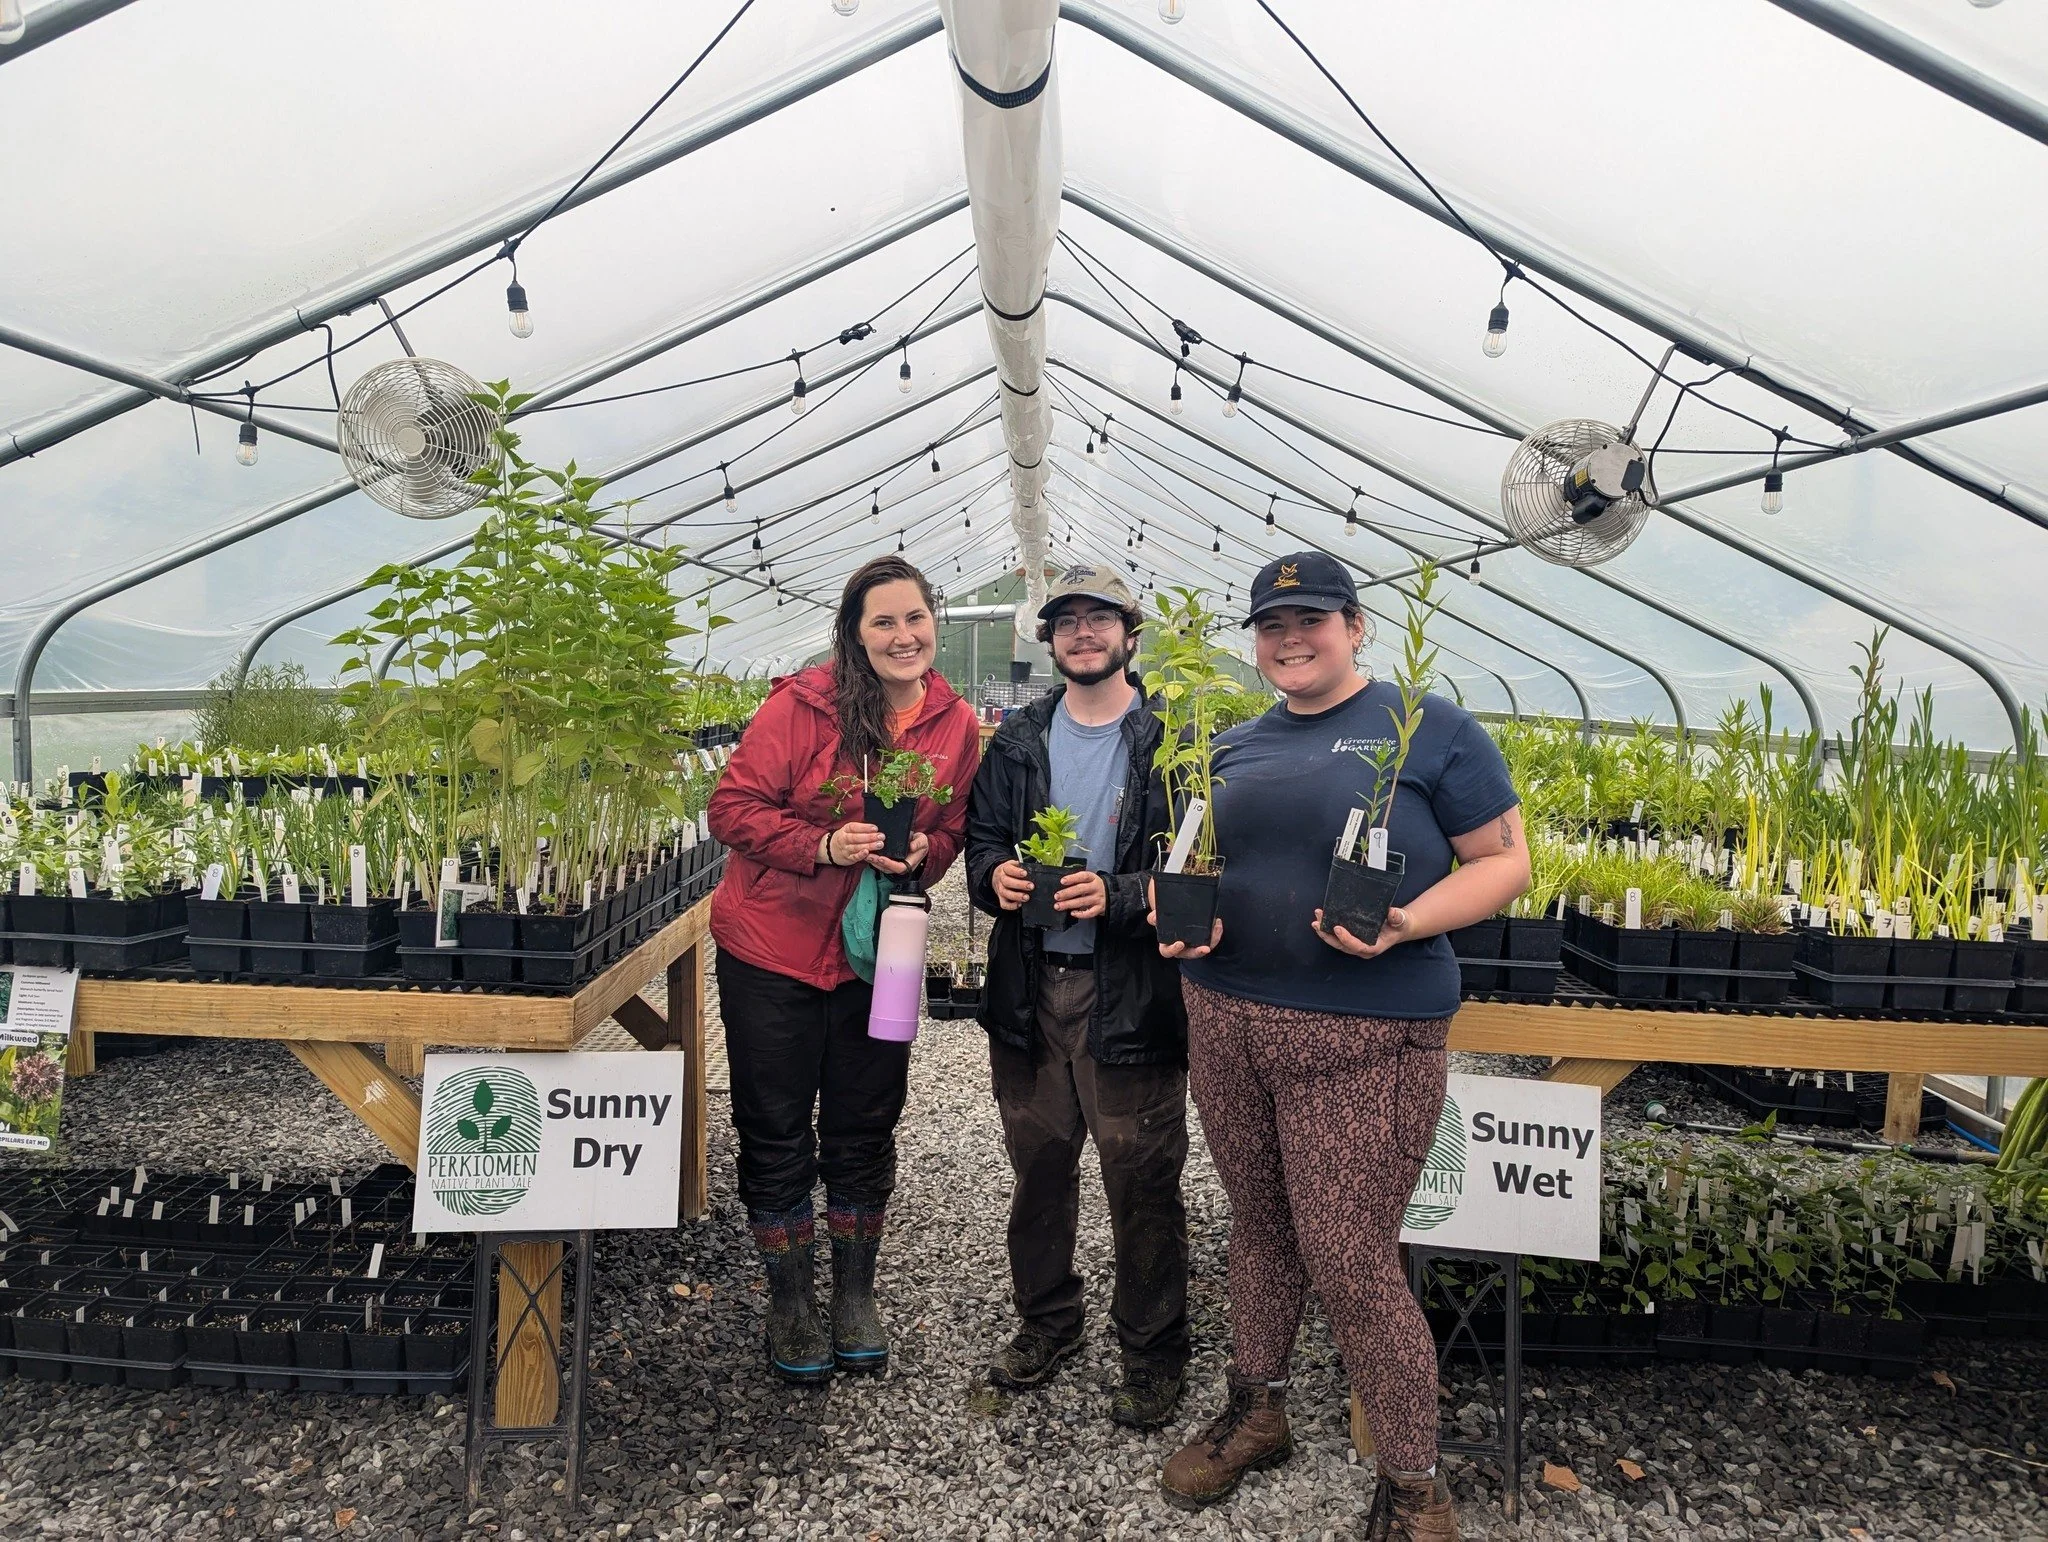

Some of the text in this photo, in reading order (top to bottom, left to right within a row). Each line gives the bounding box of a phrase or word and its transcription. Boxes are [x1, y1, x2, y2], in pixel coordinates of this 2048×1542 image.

[1343, 737, 1397, 746] Greenridge
[1193, 803, 1204, 812] 10
[1373, 831, 1381, 848] 9
[24, 866, 30, 874] 8
[212, 868, 219, 878] 8
[1630, 891, 1636, 902] 8
[1883, 918, 1892, 929] 7
[547, 1089, 673, 1126] Sunny
[0, 1136, 25, 1144] PILLARS
[1471, 1111, 1595, 1160] Sunny
[573, 1137, 643, 1176] Dry
[428, 1154, 537, 1178] PERKIOMEN
[431, 1176, 532, 1190] NATIVE PLANT SALE
[1492, 1161, 1573, 1200] Wet
[1438, 1195, 1459, 1207] SALE
